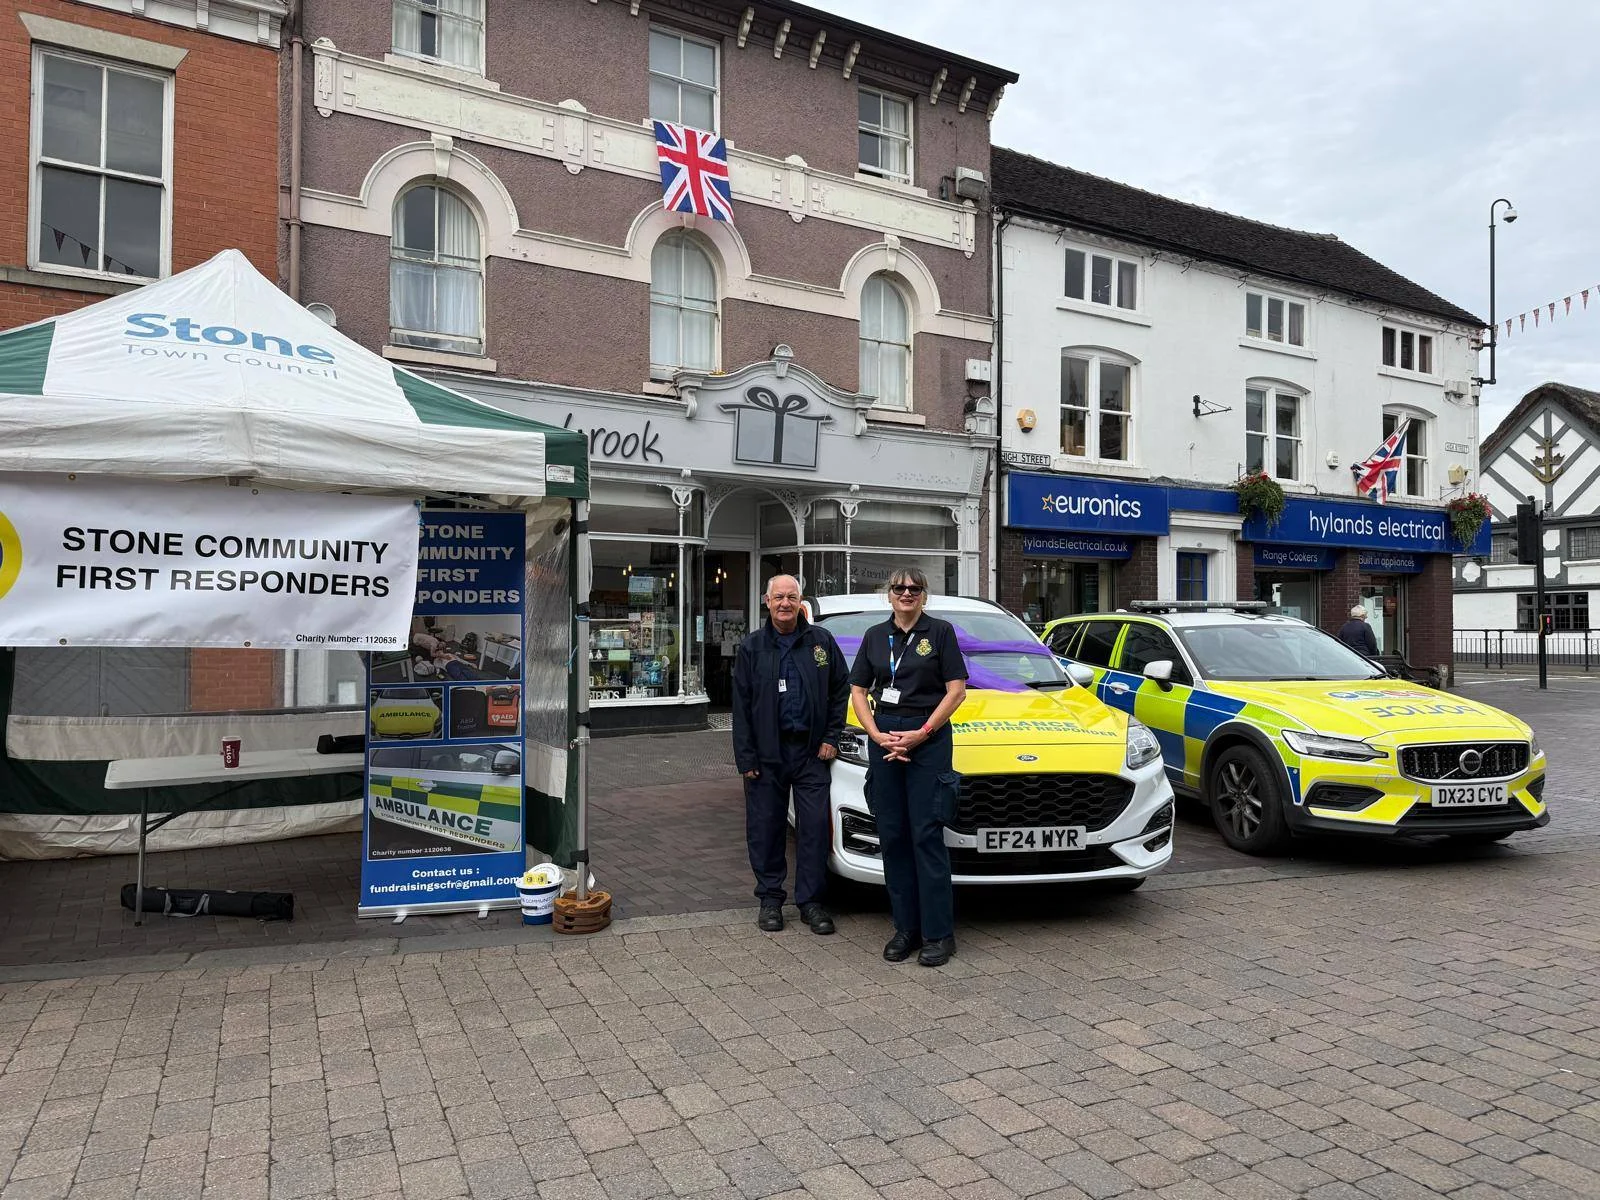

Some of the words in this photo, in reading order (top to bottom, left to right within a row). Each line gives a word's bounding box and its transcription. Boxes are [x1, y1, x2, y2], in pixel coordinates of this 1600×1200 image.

[124, 313, 335, 364] Stone
[121, 343, 208, 360] Town
[224, 353, 337, 379] Council
[564, 413, 663, 462] rook
[1002, 453, 1018, 461] HIGH
[1021, 454, 1048, 464] STREET
[1055, 494, 1141, 518] euronics
[1310, 510, 1373, 538] hylands
[1378, 517, 1445, 540] electrical
[62, 527, 183, 556] STONE
[195, 535, 389, 563] COMMUNITY
[418, 546, 515, 560] MMUNITY
[1262, 550, 1288, 564] Range
[1289, 551, 1318, 563] Cookers
[57, 564, 160, 590] FIRST
[170, 570, 389, 598] RESPONDERS
[417, 568, 480, 582] FIRST
[415, 590, 520, 604] PONDERS
[296, 634, 326, 644] Charity
[328, 635, 363, 643] Number:
[365, 636, 397, 644] 1120636
[953, 721, 1078, 729] MBULANCE
[1035, 726, 1118, 737] RESPONDER
[1439, 788, 1475, 804] DX23
[1478, 786, 1503, 803] CYC
[375, 796, 493, 837] AMBULANCE
[429, 825, 447, 833] FIRST
[450, 830, 505, 849] RESPONDERS
[985, 830, 1036, 849] EF24
[1042, 829, 1079, 848] WYR
[412, 868, 457, 878] Contact
